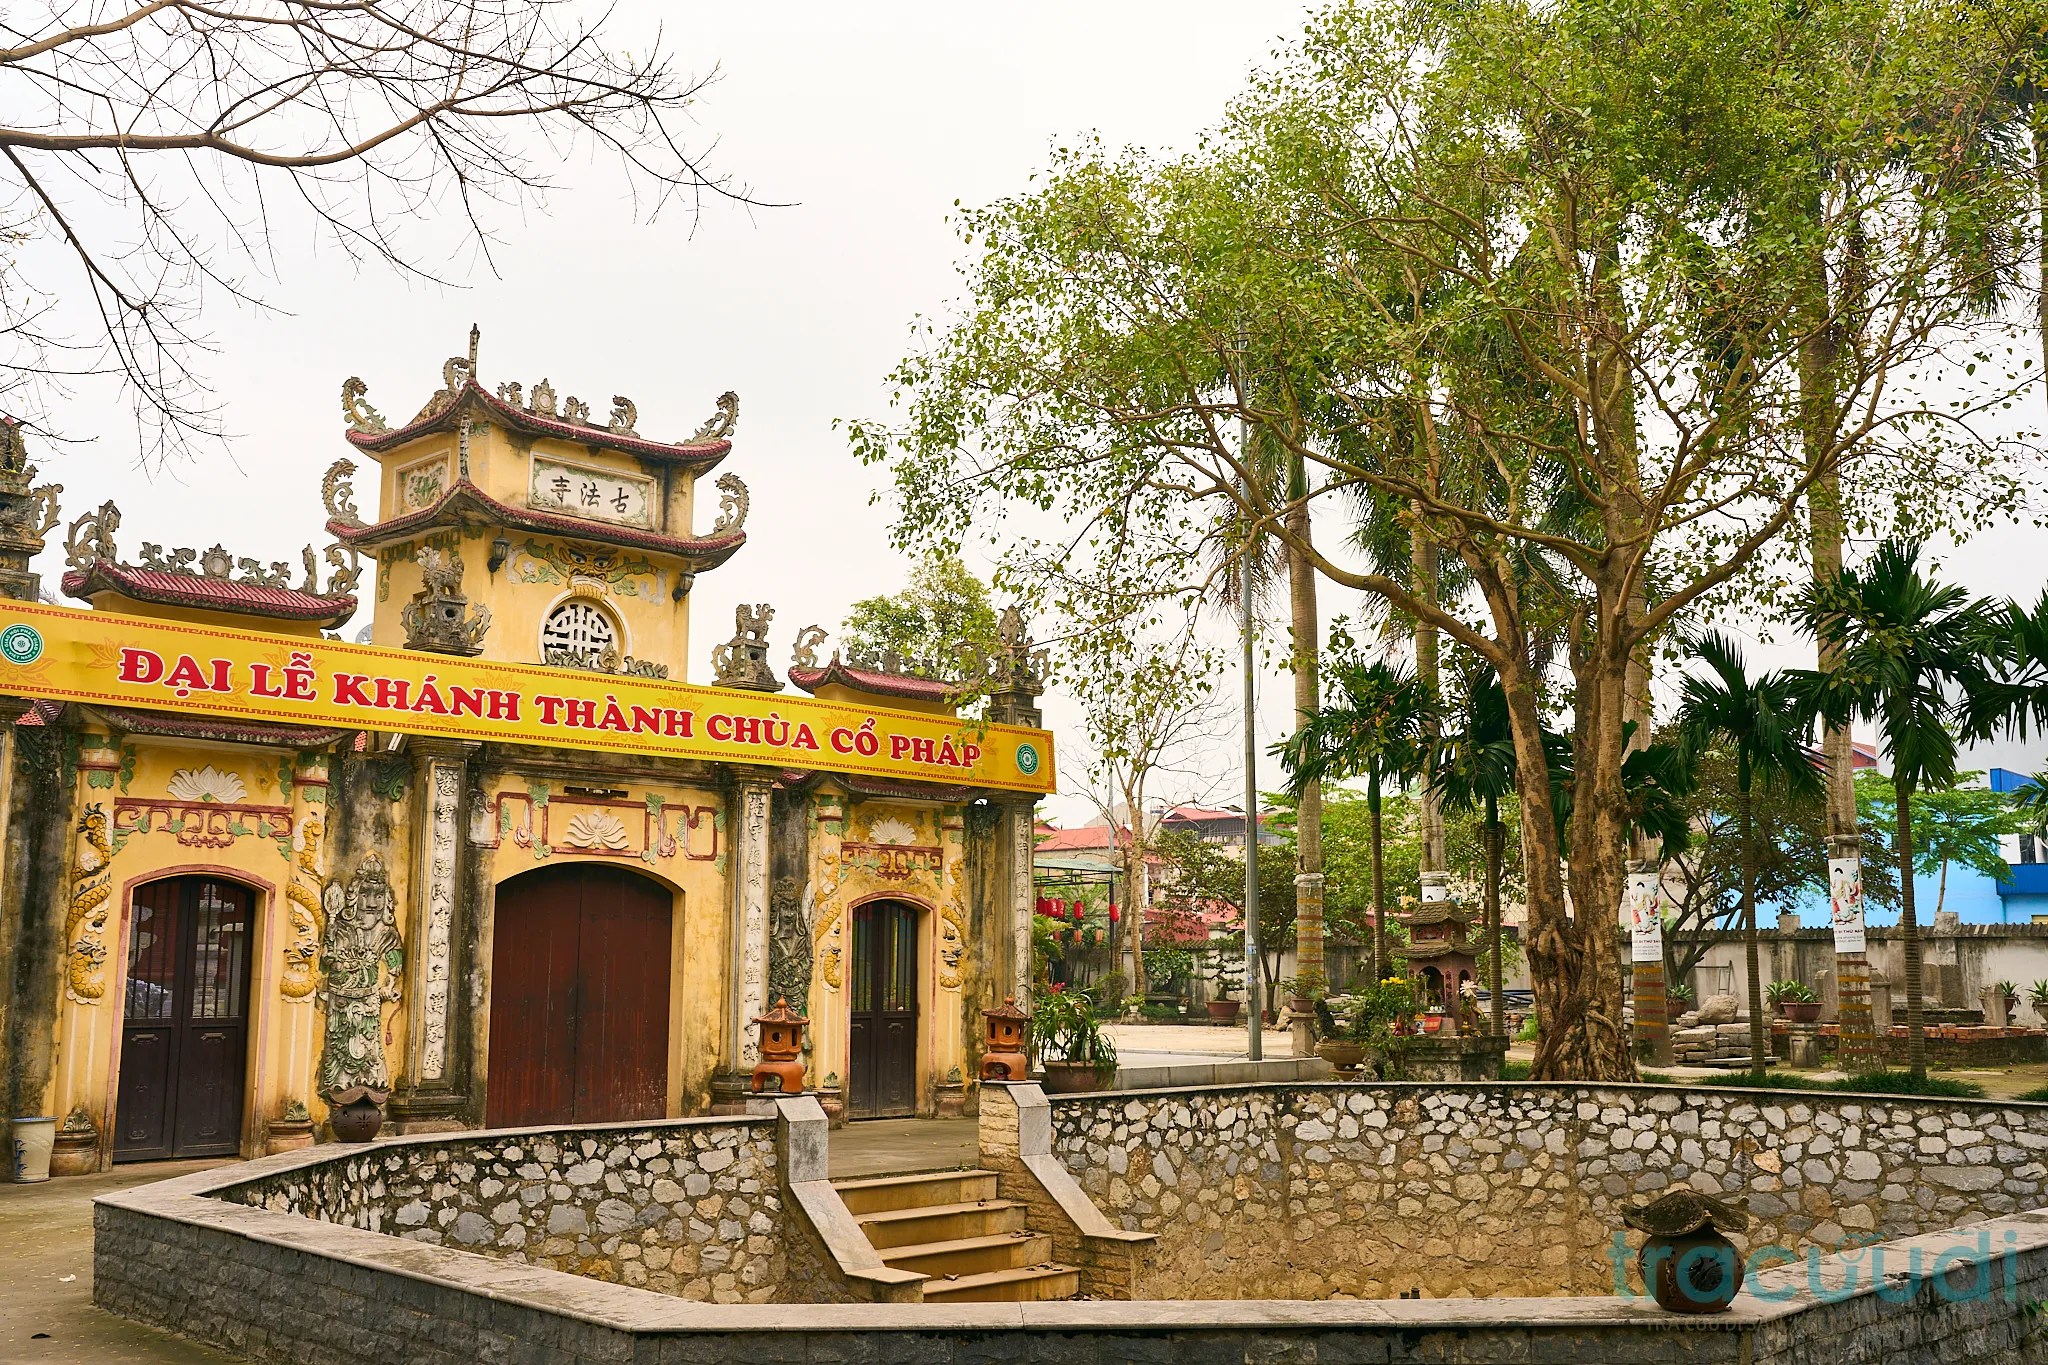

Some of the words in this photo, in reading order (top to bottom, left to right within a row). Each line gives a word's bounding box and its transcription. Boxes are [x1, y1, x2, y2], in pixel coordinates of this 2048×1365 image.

[118, 647, 233, 698] ĐẠI
[249, 651, 317, 702] LỄ
[331, 673, 522, 722] KHÁNH
[534, 694, 694, 739] THÀNH
[705, 712, 820, 751] CHÙA
[830, 716, 879, 757] CỔ
[889, 734, 981, 768] PHÁP
